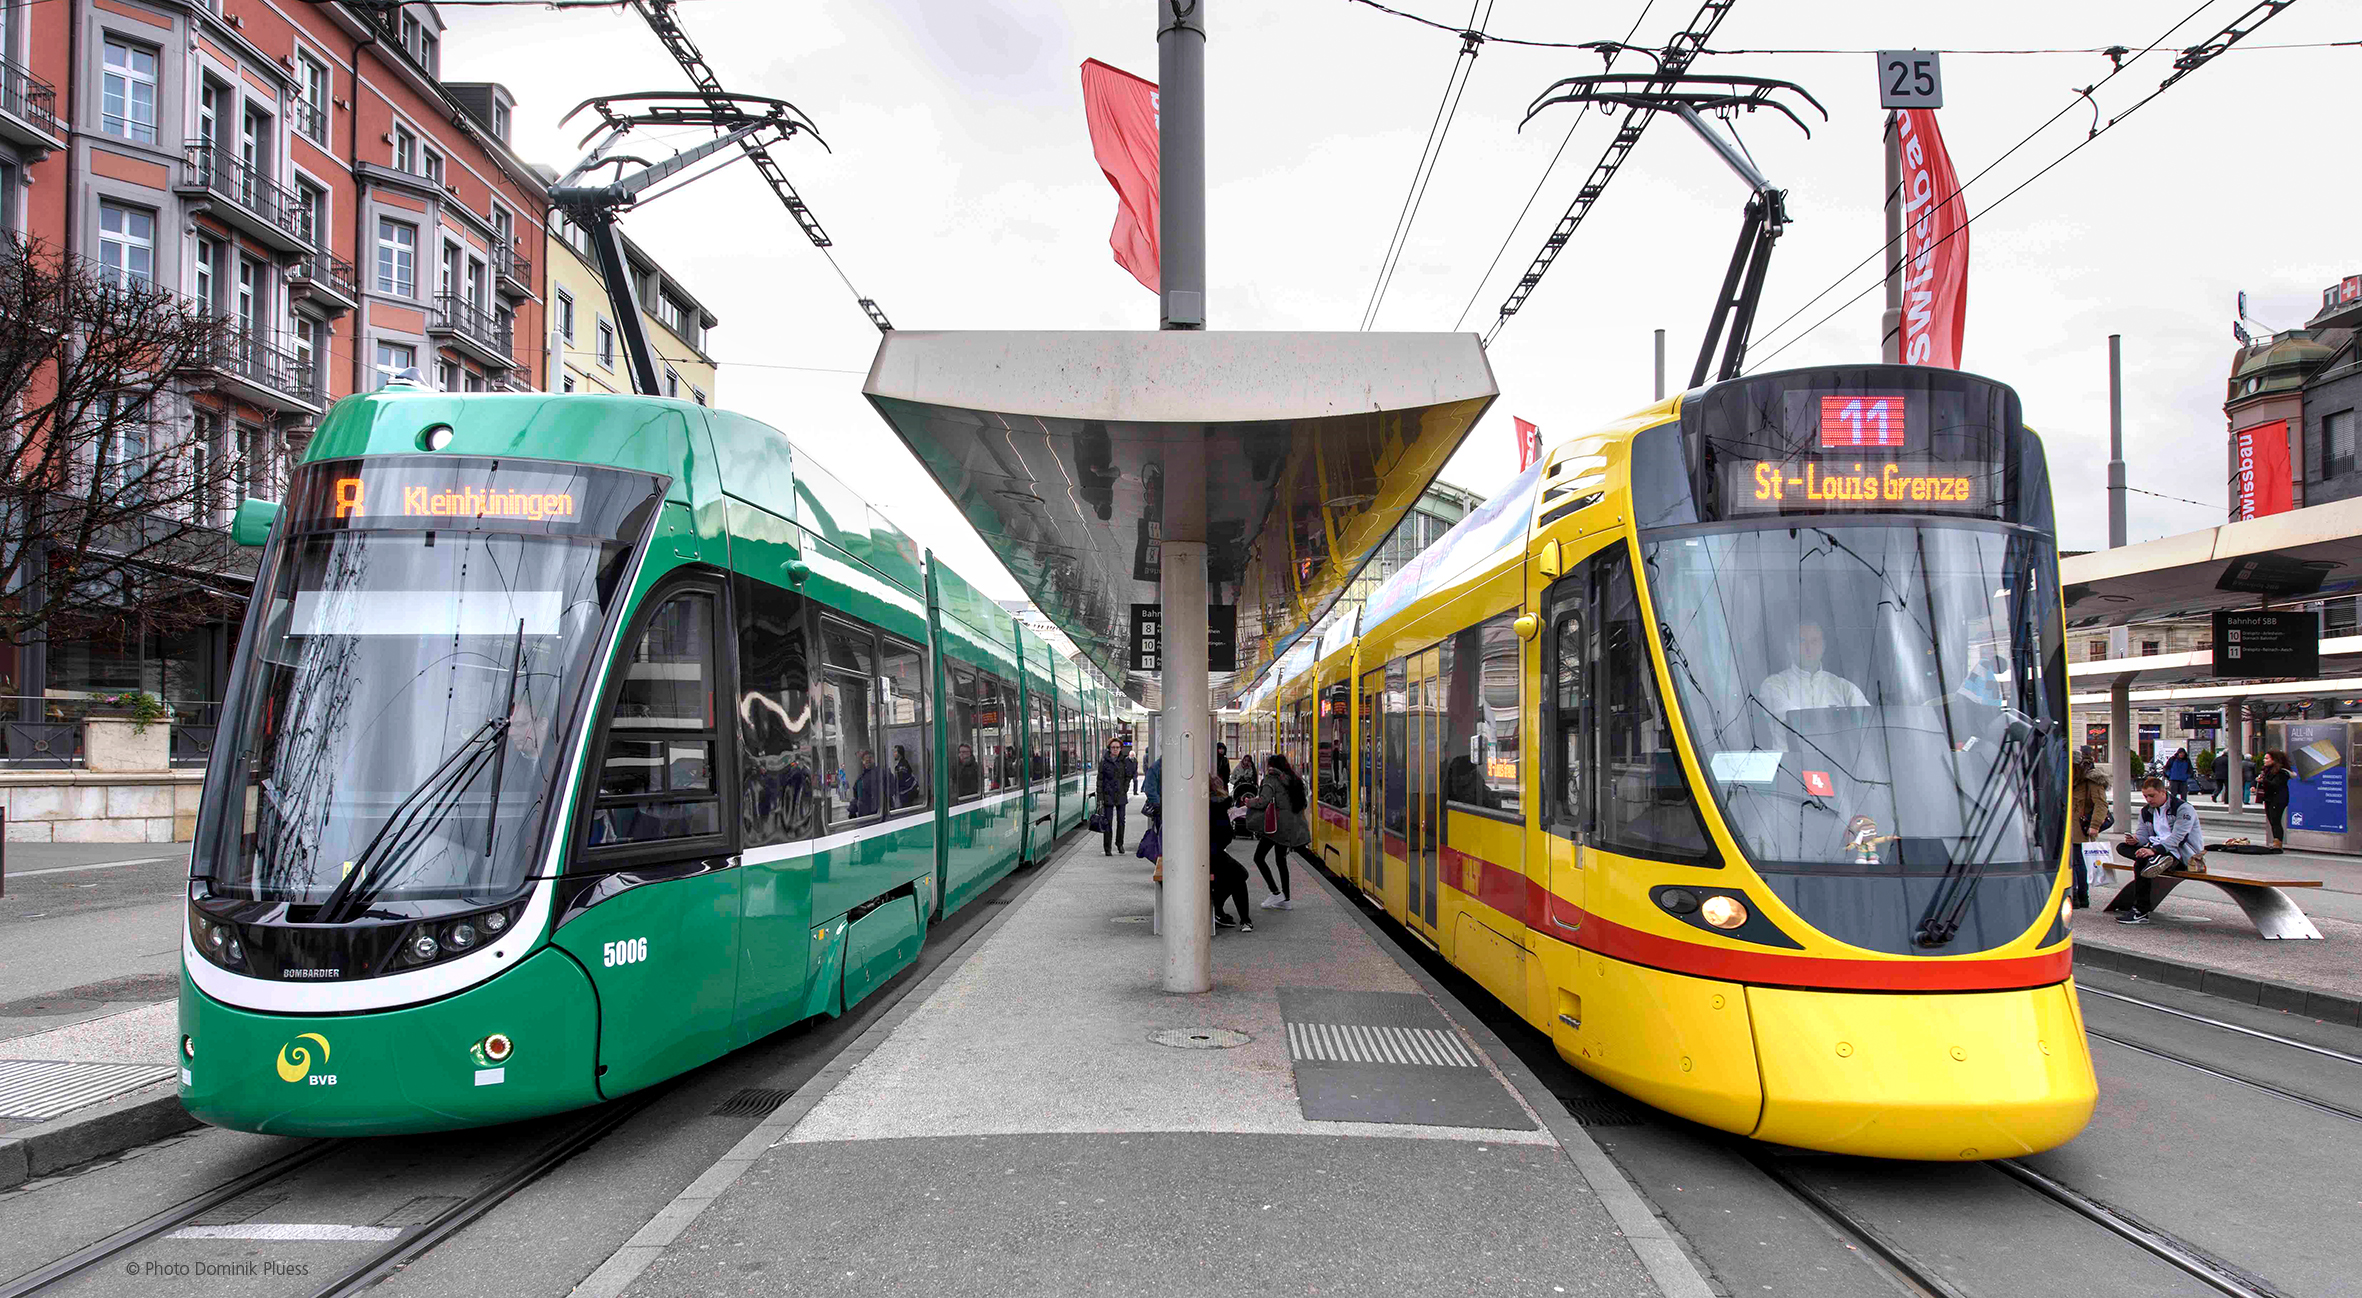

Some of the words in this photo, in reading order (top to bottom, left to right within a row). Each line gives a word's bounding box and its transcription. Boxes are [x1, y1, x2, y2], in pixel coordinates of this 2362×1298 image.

[1888, 61, 1935, 96] 25
[1897, 109, 1933, 365] swissbau
[1840, 400, 1888, 444] 11
[1883, 463, 1970, 501] Grenze
[2239, 434, 2255, 523] swissbau
[404, 485, 573, 521] Kleinhüningen
[2227, 617, 2261, 625] Bahnhof
[2262, 617, 2277, 625] SBB
[2230, 632, 2240, 640] 10
[1144, 641, 1154, 650] 10
[2230, 648, 2239, 656] 11
[1144, 657, 1153, 666] 11
[2291, 728, 2314, 737] ALL-IN
[1812, 774, 1824, 789] 4
[604, 936, 648, 967] 5006
[283, 969, 340, 978] BOMBARDIER
[309, 1075, 338, 1086] BVB
